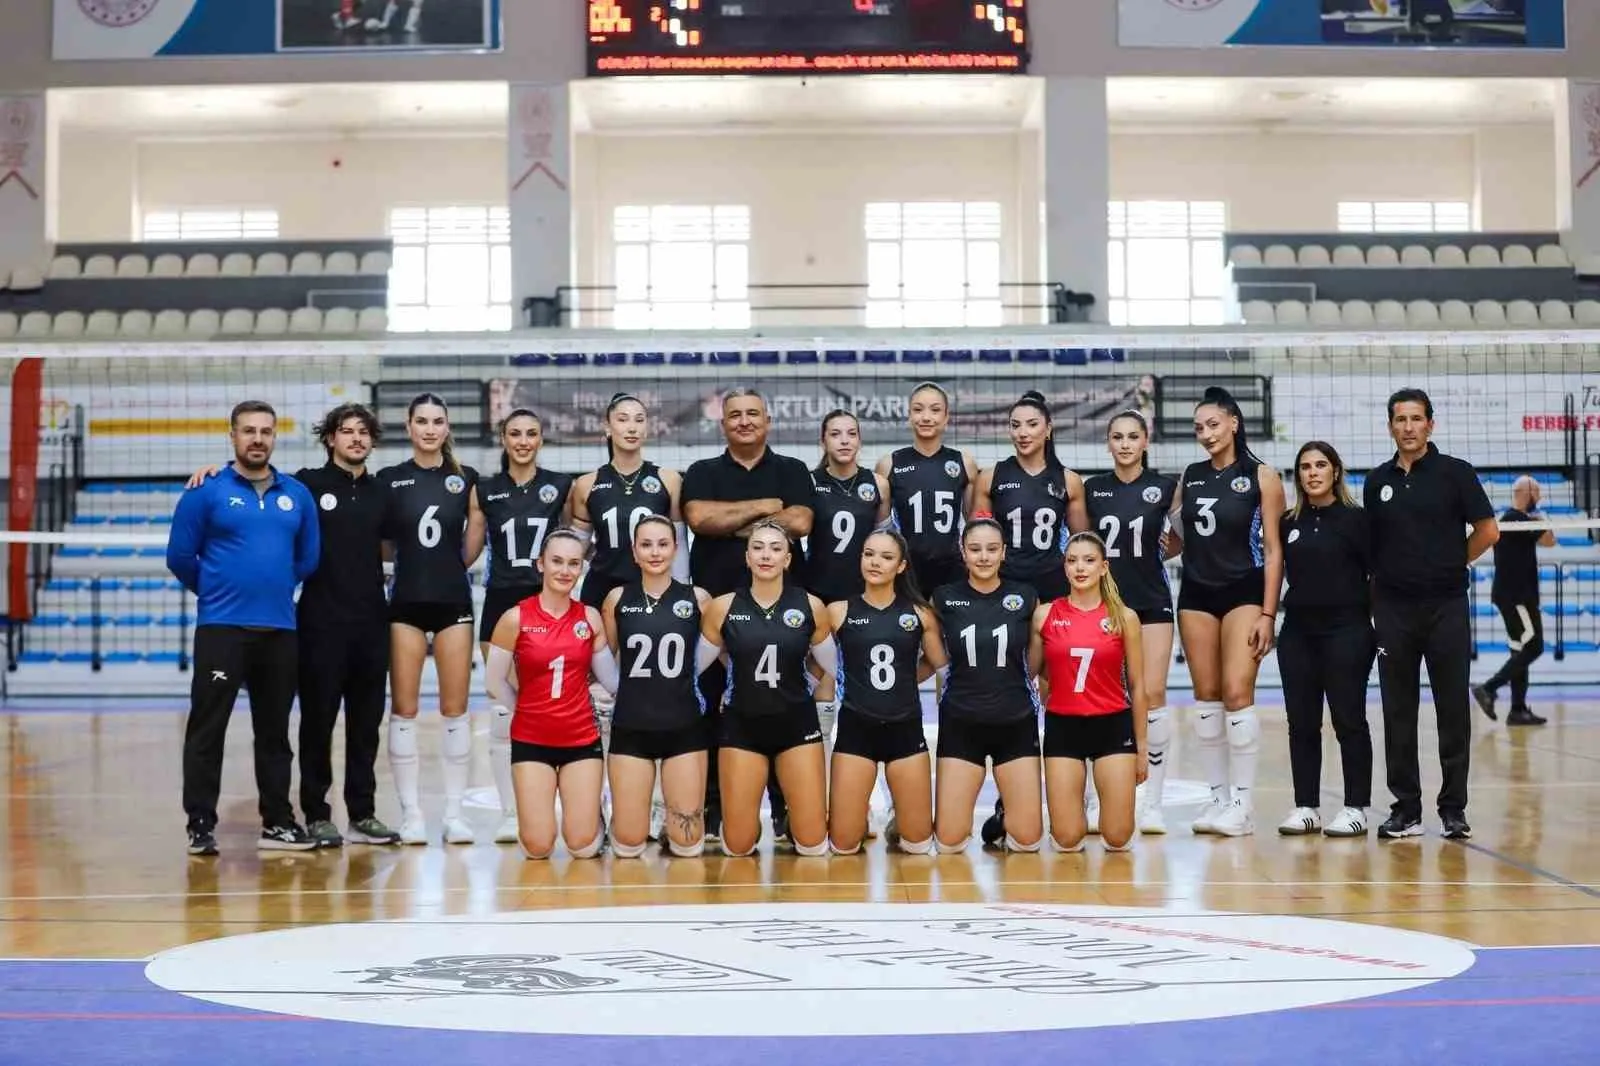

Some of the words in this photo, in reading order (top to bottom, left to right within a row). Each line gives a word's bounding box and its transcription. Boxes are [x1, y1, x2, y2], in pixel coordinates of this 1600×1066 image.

[418, 505, 442, 548] 6
[832, 510, 856, 553] 9
[908, 490, 954, 534] 15
[1006, 506, 1057, 550] 18
[1194, 497, 1219, 537] 3
[500, 517, 549, 561] 17
[1099, 514, 1144, 558] 21
[626, 632, 686, 679] 20
[754, 644, 781, 689] 4
[869, 643, 896, 691] 8
[960, 623, 1008, 667] 11
[548, 654, 566, 699] 1
[1069, 647, 1096, 693] 7
[922, 921, 1250, 969] Motors
